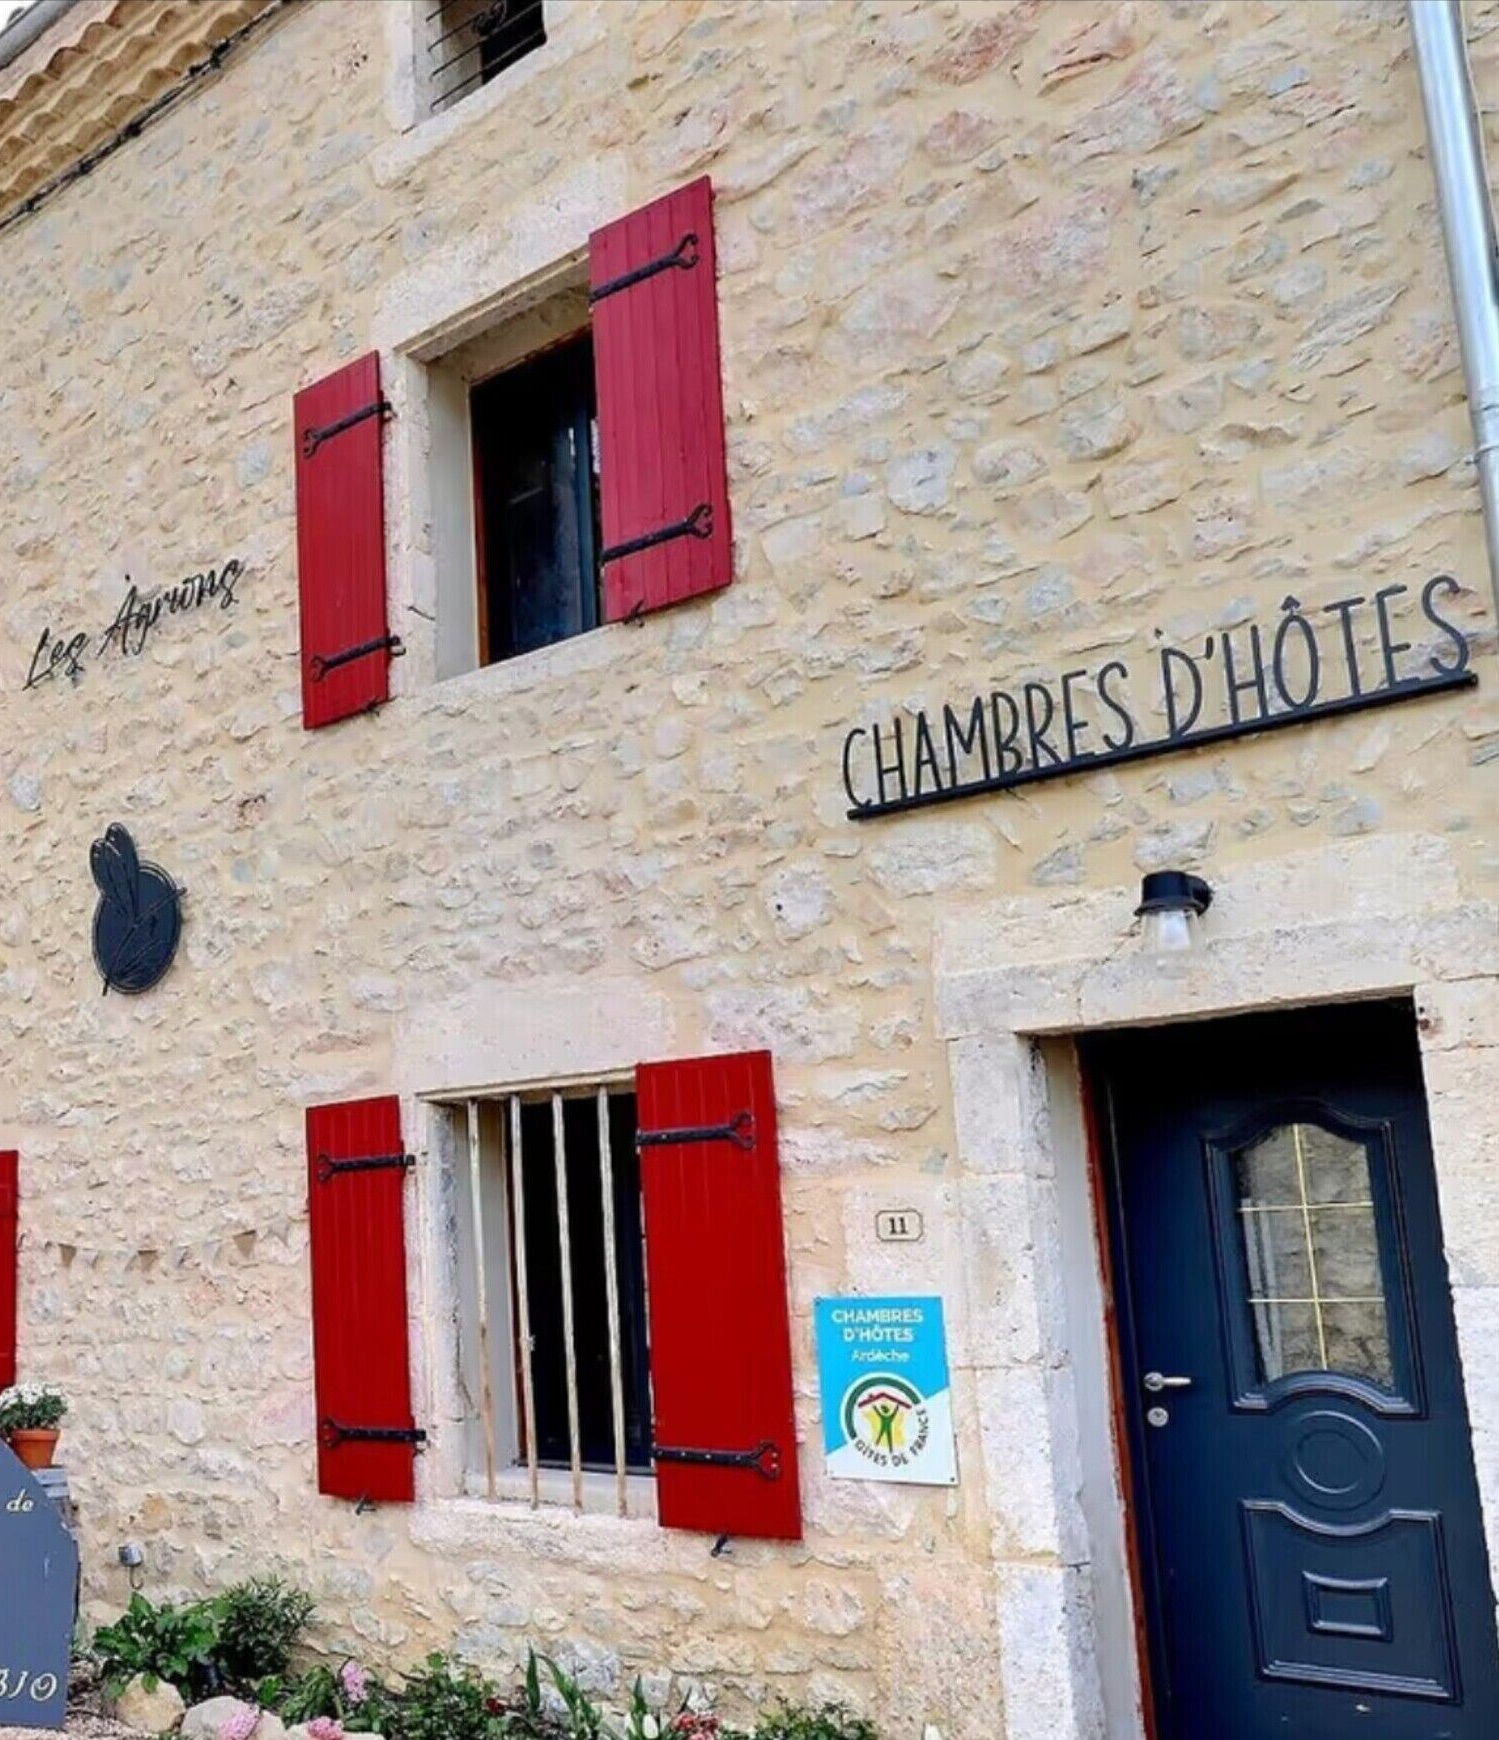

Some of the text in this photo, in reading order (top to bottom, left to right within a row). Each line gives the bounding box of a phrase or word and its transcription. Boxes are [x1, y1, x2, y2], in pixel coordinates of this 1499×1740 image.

[22, 626, 90, 691] Les
[842, 575, 1470, 809] CHAMBRES D'HÔTES
[888, 1215, 908, 1236] 11
[831, 1307, 925, 1324] CHAMBRES
[843, 1323, 915, 1343] D'HÔTES
[852, 1348, 910, 1363] Ardèche
[6, 1489, 35, 1512] de
